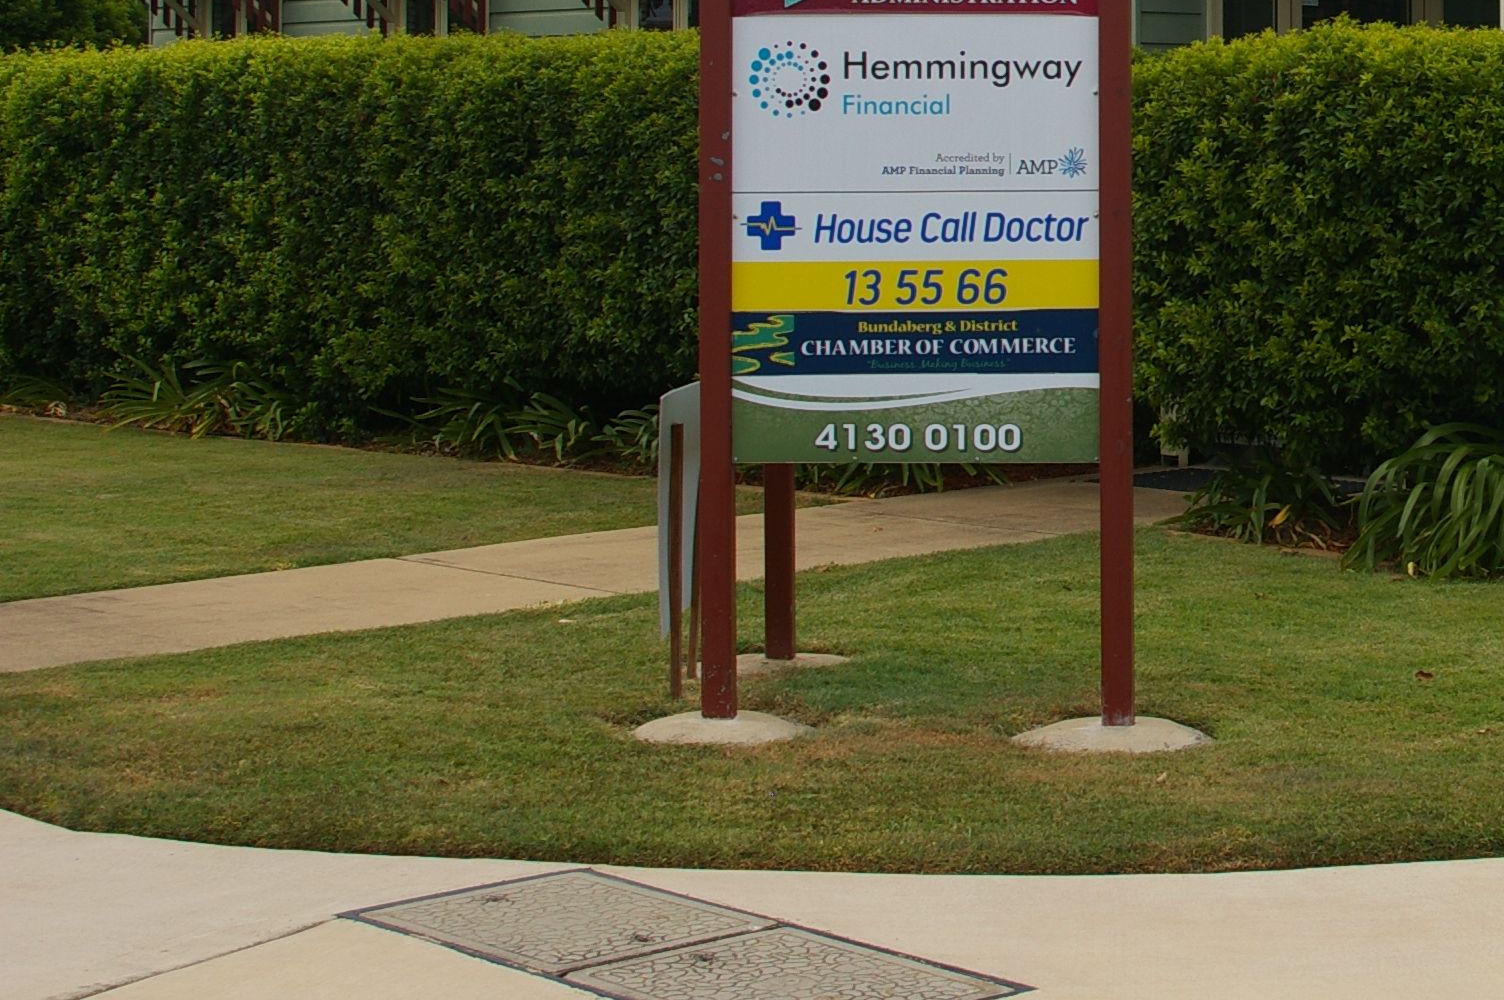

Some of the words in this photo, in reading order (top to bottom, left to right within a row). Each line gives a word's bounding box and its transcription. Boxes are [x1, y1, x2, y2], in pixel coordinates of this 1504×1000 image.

[843, 50, 1083, 88] Hemmingway
[842, 94, 951, 116] Financial
[935, 153, 990, 163] Accredited
[992, 153, 1005, 165] by
[1016, 159, 1059, 175] AMP
[881, 166, 907, 176] AMP
[909, 166, 957, 176] Financial
[959, 166, 1005, 177] Planning
[814, 213, 912, 244] House
[920, 212, 977, 243] Call
[983, 212, 1090, 243] Doctor
[844, 268, 882, 305] 13
[895, 269, 944, 305] 55
[956, 268, 1009, 305] 66
[857, 321, 942, 335] Bundaberg
[945, 321, 957, 333] &
[959, 320, 1019, 332] District
[801, 338, 912, 356] CHAMBER
[915, 339, 944, 355] OF
[950, 337, 1077, 355] COMMERCE
[814, 423, 912, 452] 4130
[924, 423, 1023, 452] 0100
